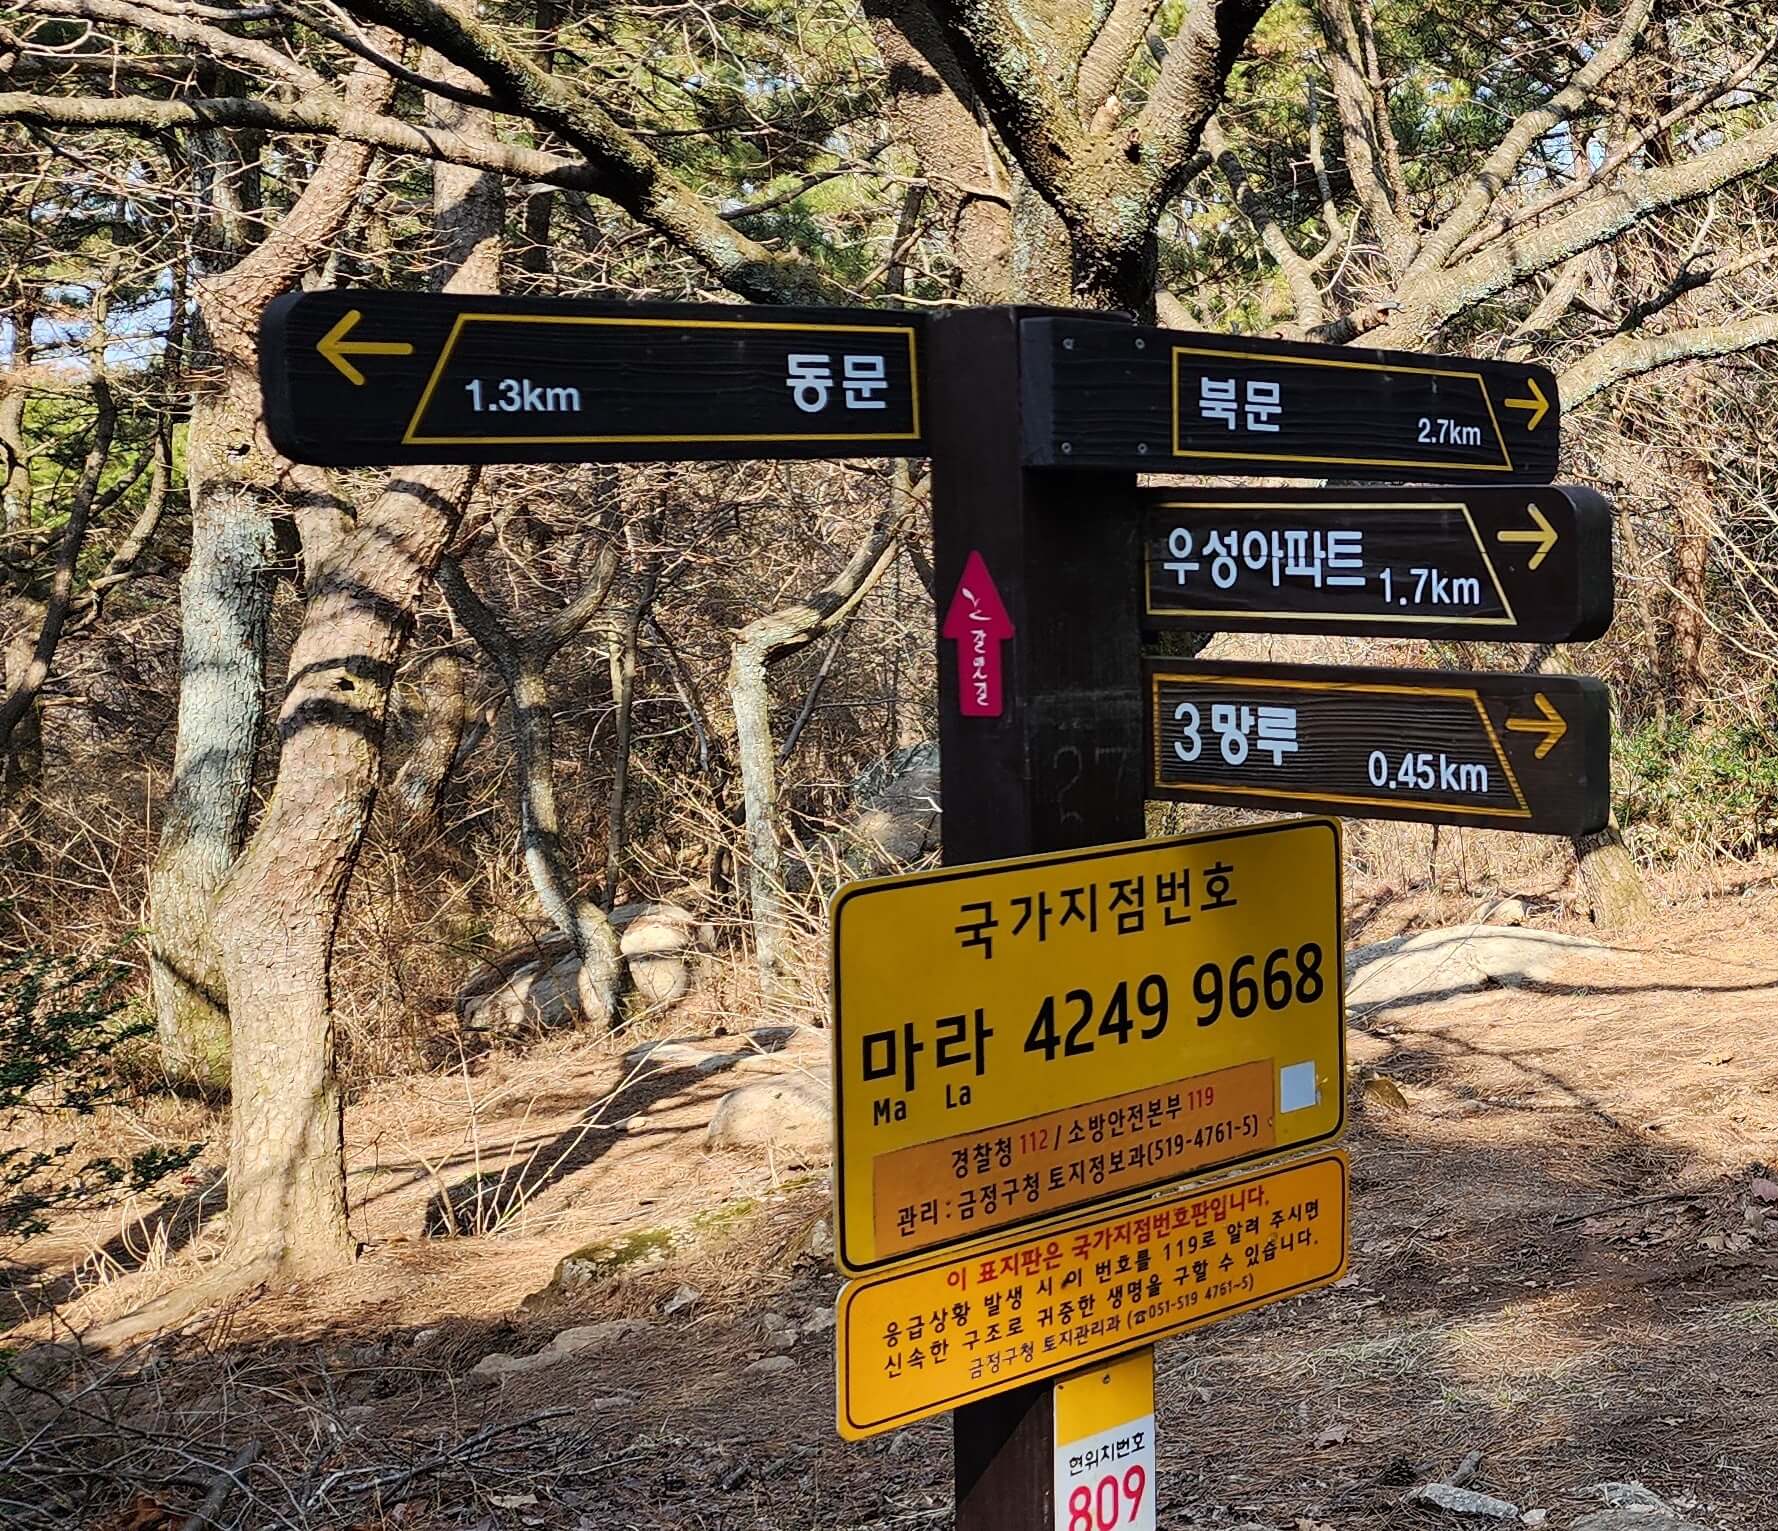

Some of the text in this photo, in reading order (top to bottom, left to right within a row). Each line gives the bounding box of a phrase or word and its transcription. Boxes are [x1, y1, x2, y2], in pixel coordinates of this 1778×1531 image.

[465, 379, 581, 413] 1.3km
[787, 353, 887, 413] 동문
[1199, 377, 1282, 432] 북문
[1417, 418, 1481, 447] 2.7km
[1163, 527, 1366, 588] 우성아파트
[1380, 567, 1480, 609] 1.7km
[1368, 750, 1488, 793] 0.45km
[954, 861, 1238, 960] 국가지점번호
[1024, 974, 1169, 1062] 4249
[1193, 943, 1324, 1027] 9668
[873, 1083, 971, 1126] Ma La
[952, 1137, 1012, 1179] 경찰청
[1020, 1129, 1048, 1154] 112
[1068, 1094, 1183, 1144] 소방안전본부
[1187, 1086, 1214, 1111] 119
[958, 1172, 1040, 1221] 금정구청
[947, 1185, 1269, 1291] 이 표지판은 국가지점번호판입니다.
[883, 1301, 970, 1348] 응급상황
[984, 1285, 1022, 1318] 발생
[1036, 1277, 1052, 1296] 시
[1095, 1248, 1151, 1284] 번호를
[1163, 1229, 1216, 1261] 119로
[1227, 1217, 1260, 1245] 알려
[1270, 1199, 1319, 1228] 주시면
[884, 1227, 1318, 1379] 신속한 구조로 귀중한 생명을 구할 수 있습니다.
[968, 1341, 1034, 1379] 금정구청
[1042, 1313, 1121, 1353] 토지관리과
[1068, 1464, 1146, 1531] 809
